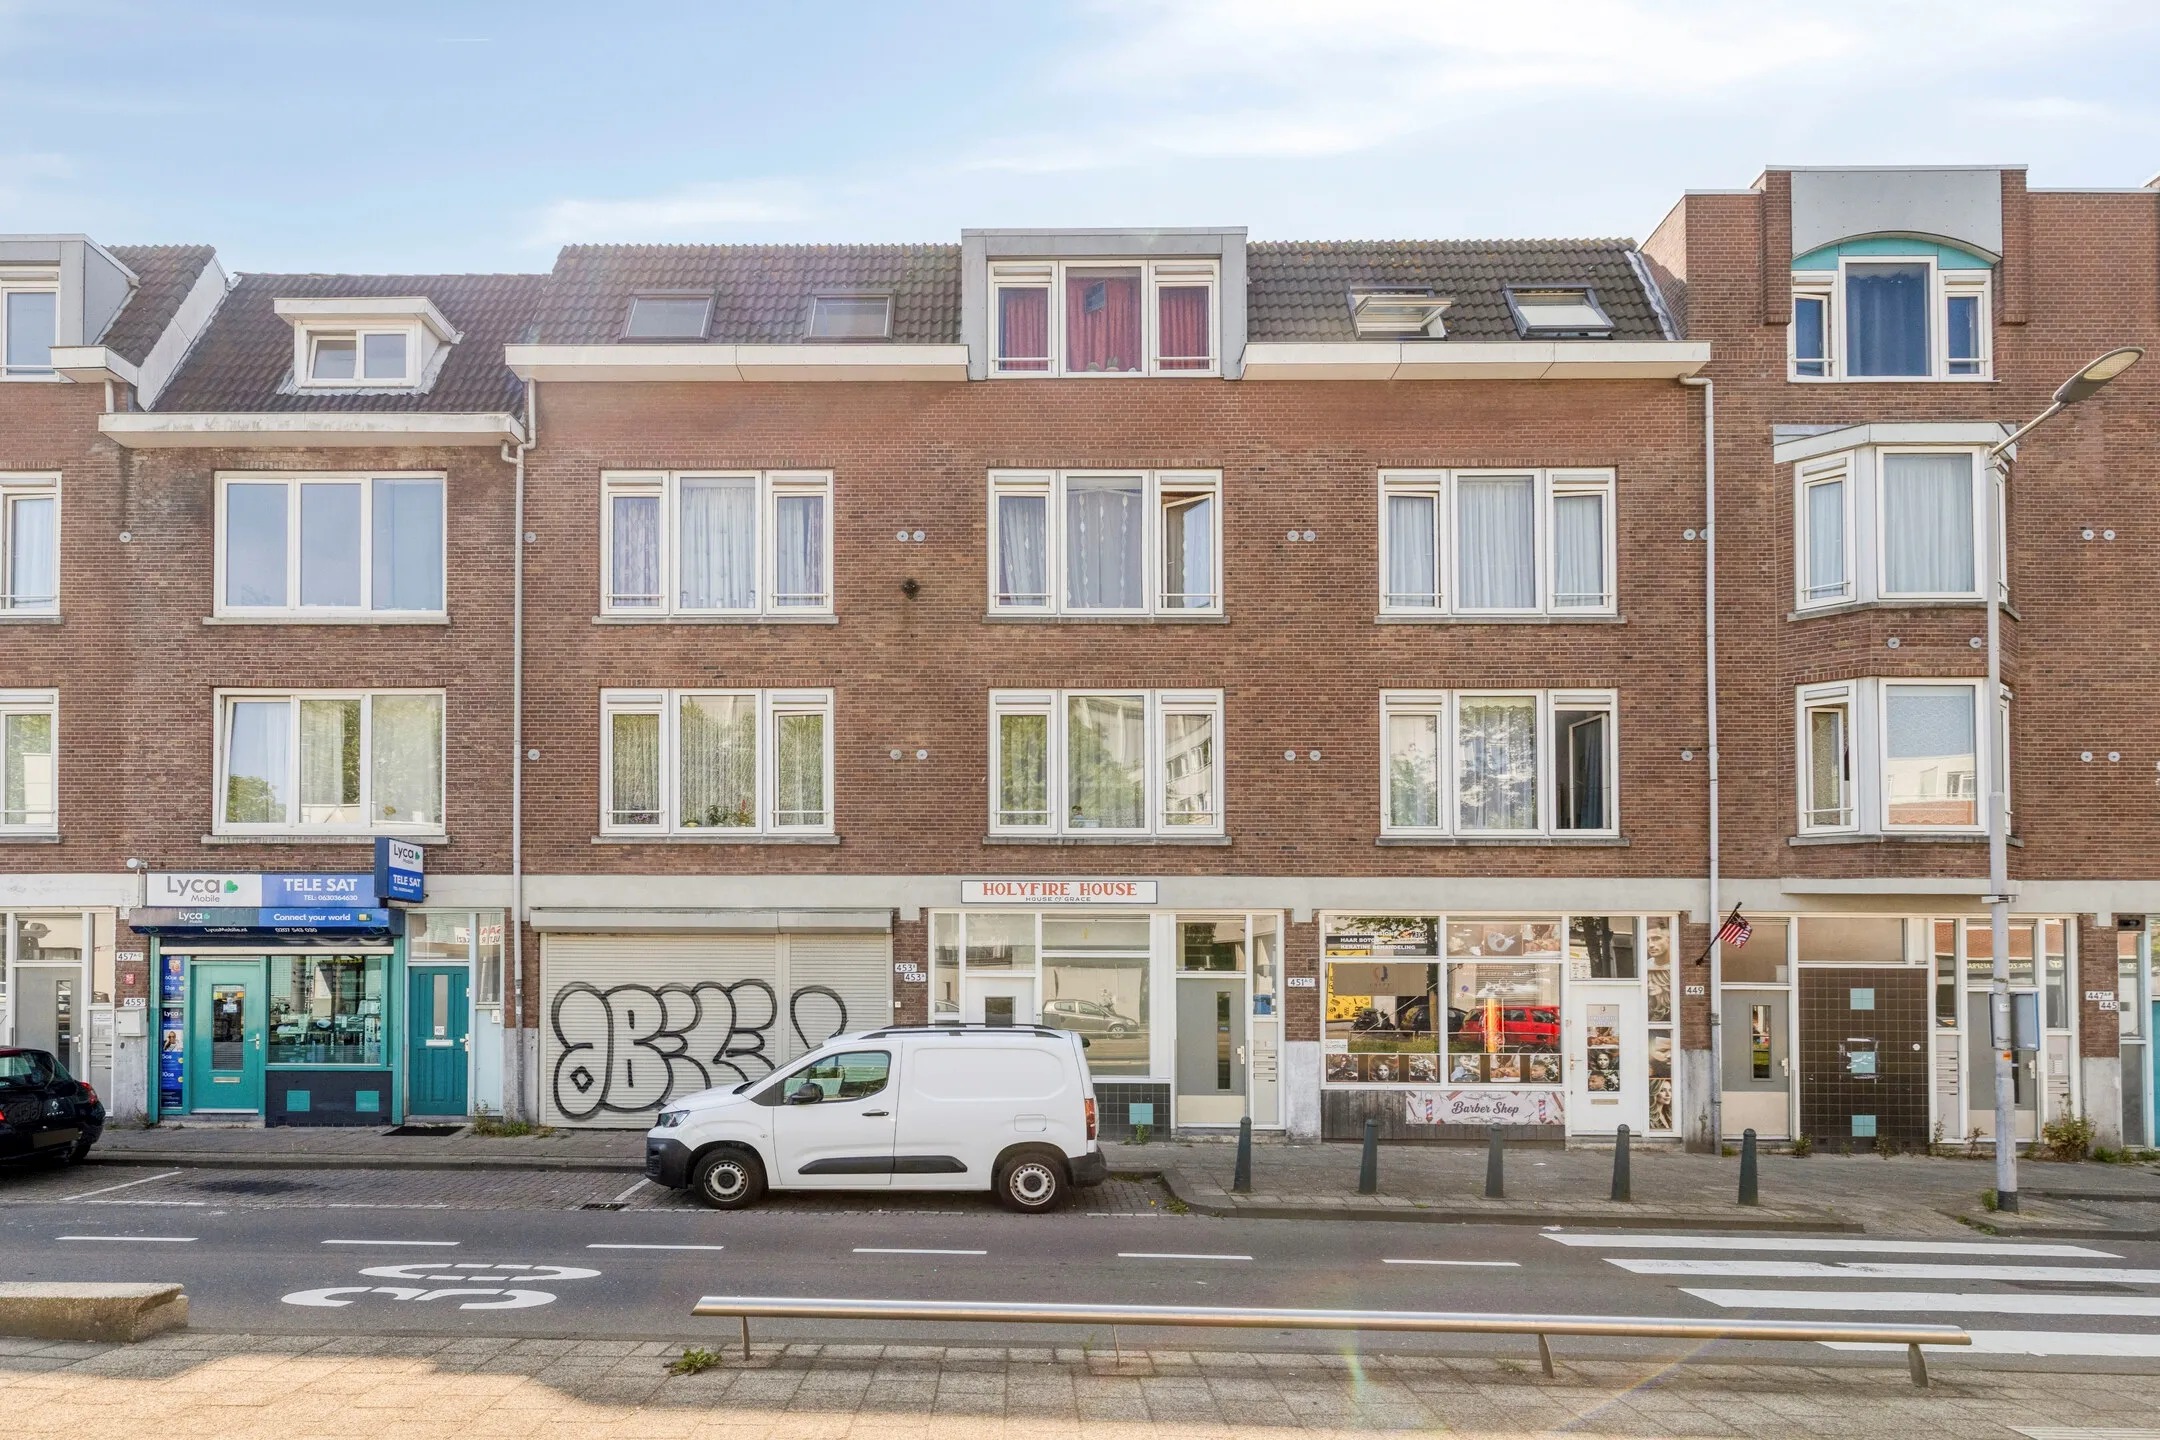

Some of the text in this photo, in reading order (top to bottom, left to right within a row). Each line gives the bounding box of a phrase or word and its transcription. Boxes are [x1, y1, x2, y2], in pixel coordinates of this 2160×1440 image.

[394, 844, 414, 858] Lyca
[167, 875, 220, 896] Lyca
[283, 878, 358, 892] TELE SAT
[393, 874, 421, 888] TELE SAT
[983, 882, 1137, 896] HOLYFIRE HOUSE
[191, 895, 220, 903] Mobile
[178, 911, 203, 921] Lyca
[273, 913, 351, 923] Connect your world
[163, 1010, 179, 1018] Lyca
[1451, 1100, 1520, 1117] Barber Shop
